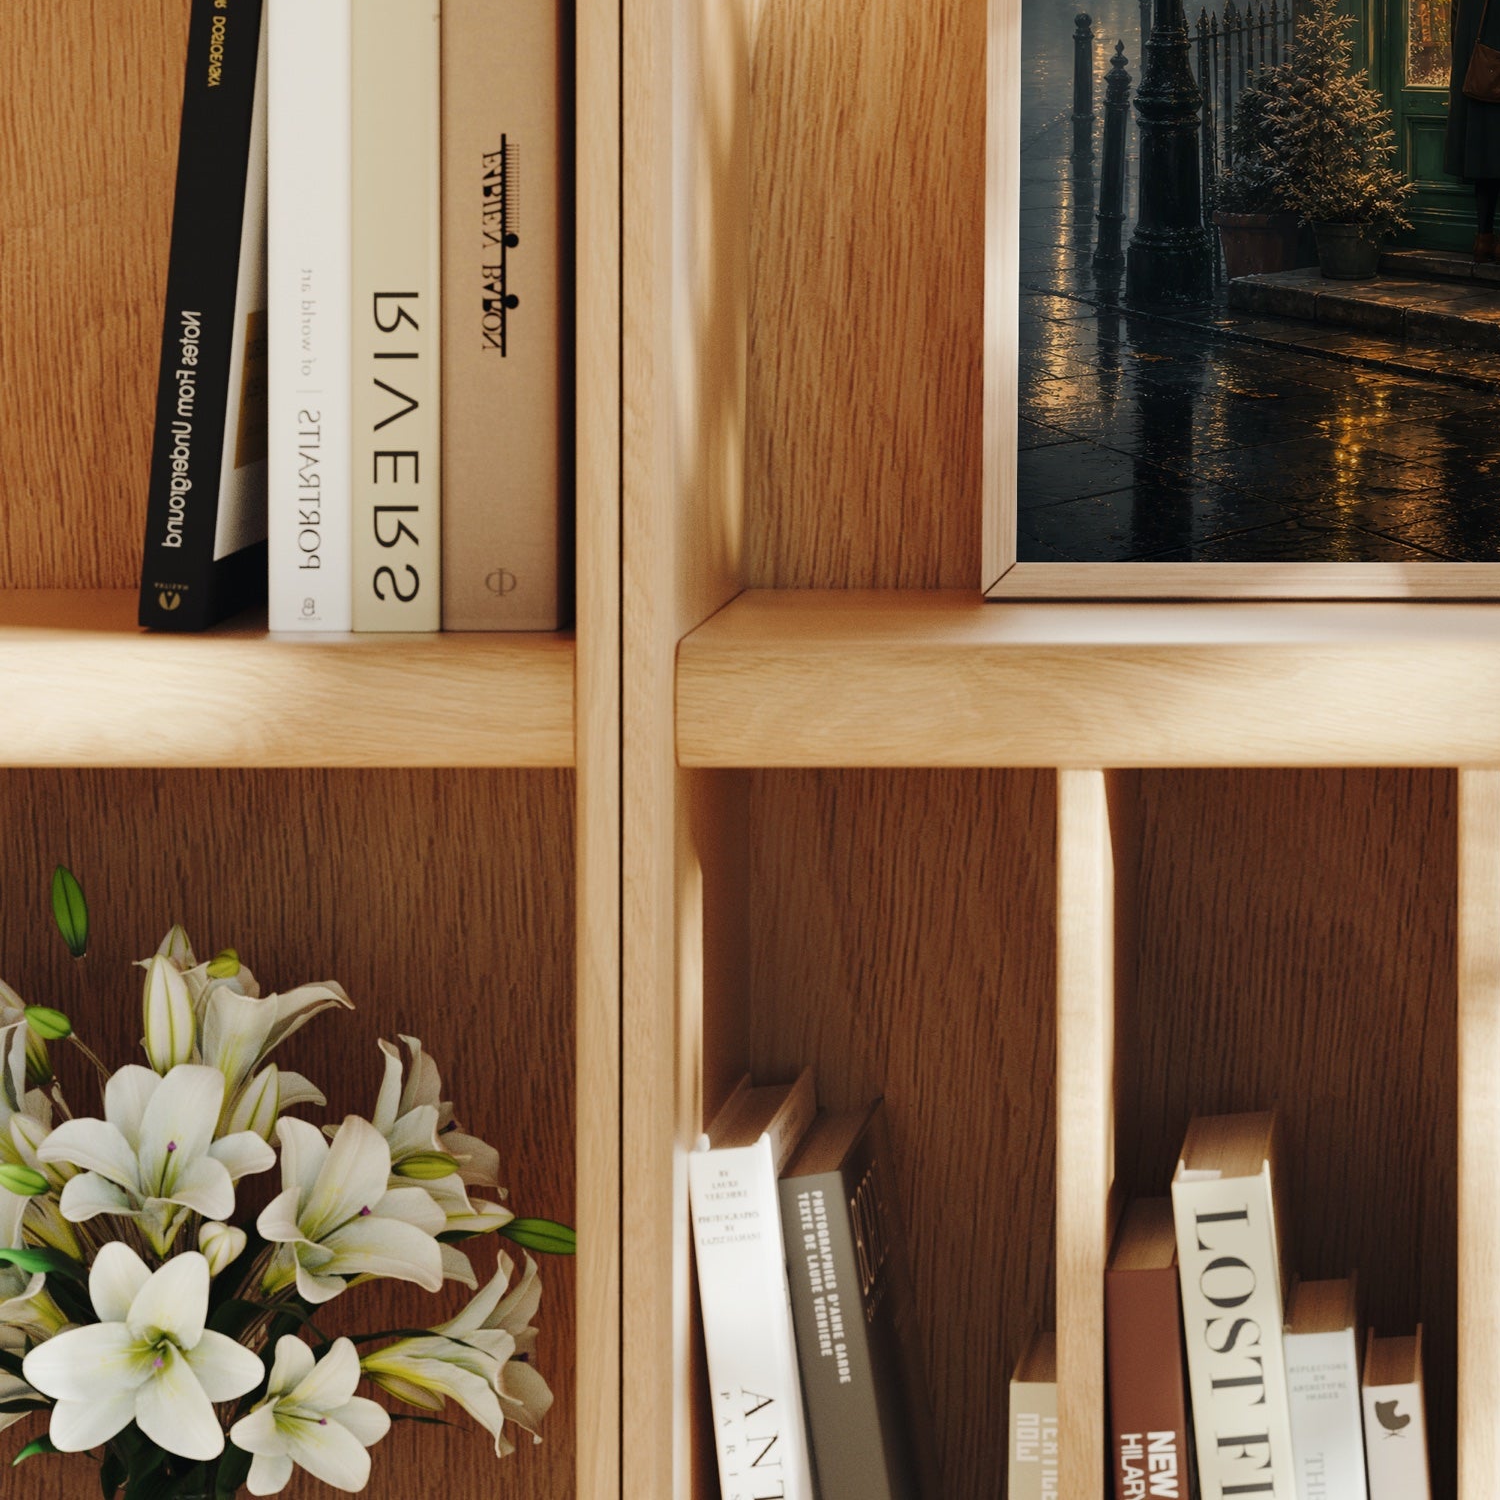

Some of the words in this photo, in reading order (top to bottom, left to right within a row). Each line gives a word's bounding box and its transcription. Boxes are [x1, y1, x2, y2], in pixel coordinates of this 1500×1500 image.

[798, 1192, 814, 1230] TEXTE
[803, 1234, 817, 1250] DE
[811, 1190, 838, 1290] PHOTOGRAPHIES
[806, 1255, 823, 1293] LAURE
[827, 1294, 844, 1339] D'ANNE
[1194, 1202, 1266, 1406] LOST
[834, 1343, 851, 1384] GARDE
[1147, 1430, 1179, 1499] NEW
